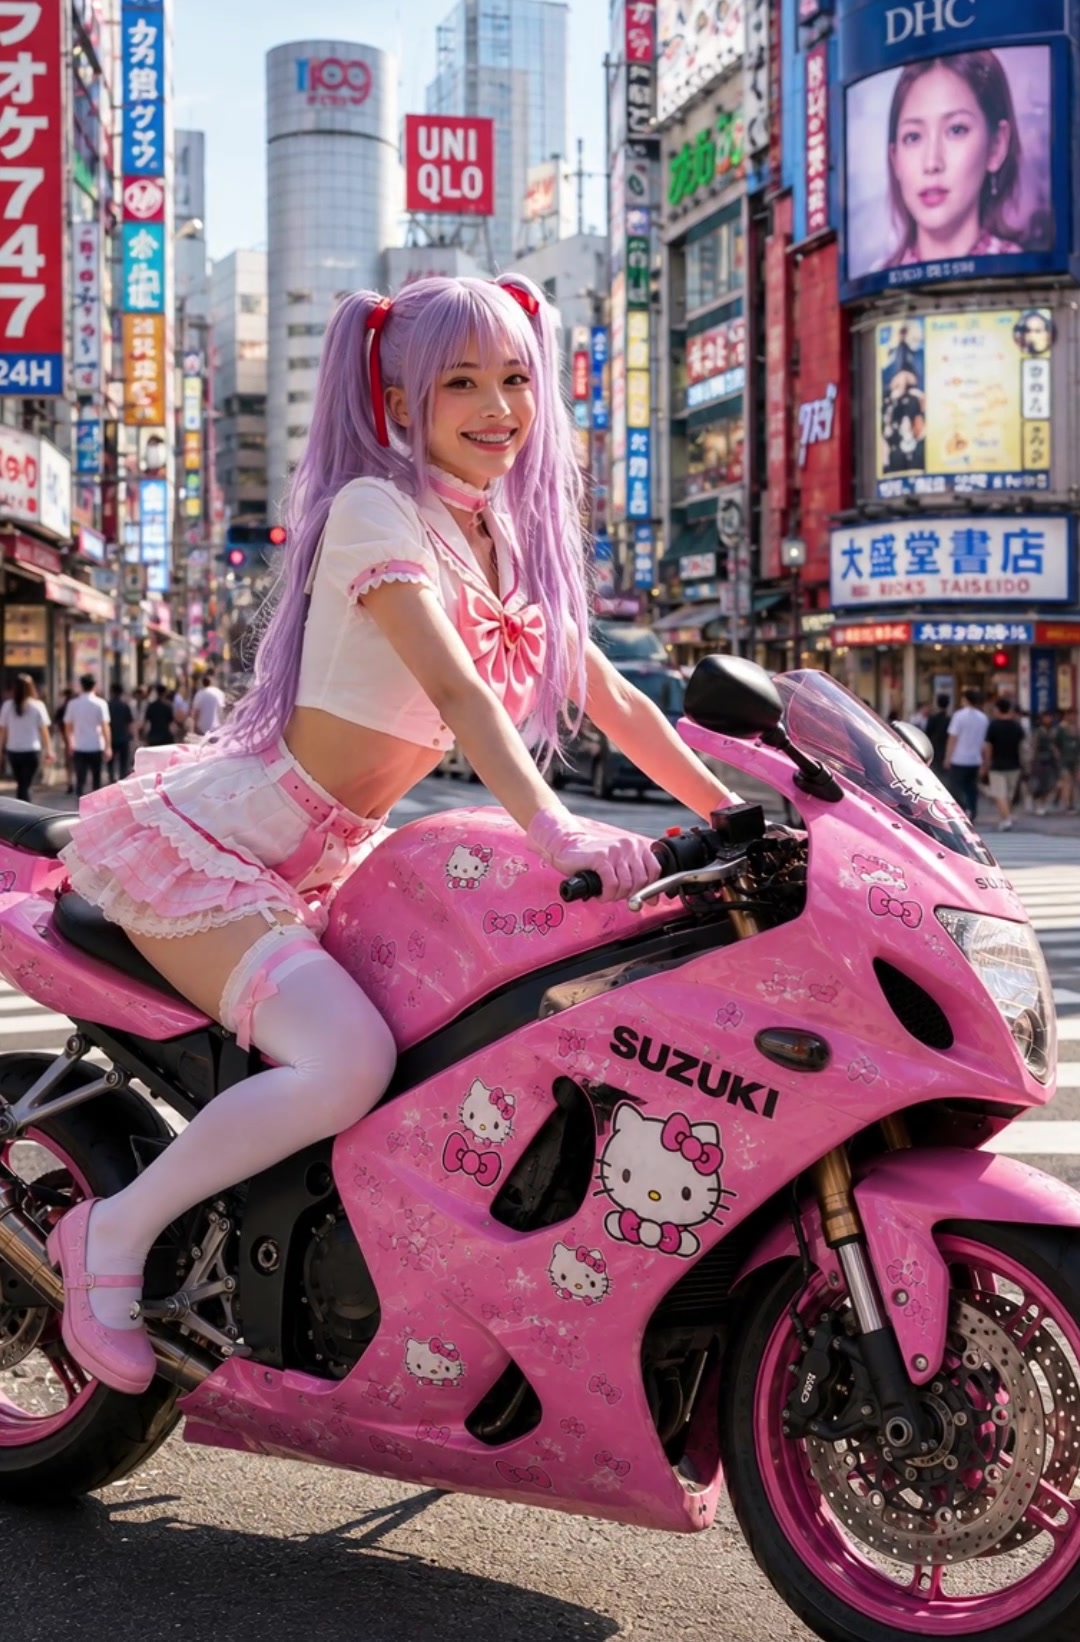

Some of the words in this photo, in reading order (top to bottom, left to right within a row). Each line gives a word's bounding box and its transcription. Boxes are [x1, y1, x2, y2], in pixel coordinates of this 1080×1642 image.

[885, 0, 976, 45] DHC
[417, 126, 477, 161] UNI
[417, 163, 484, 203] QLO
[840, 527, 1045, 580] 大盛堂書店
[941, 579, 1030, 594] TAISEIDO
[609, 1025, 780, 1119] SUZUKI
